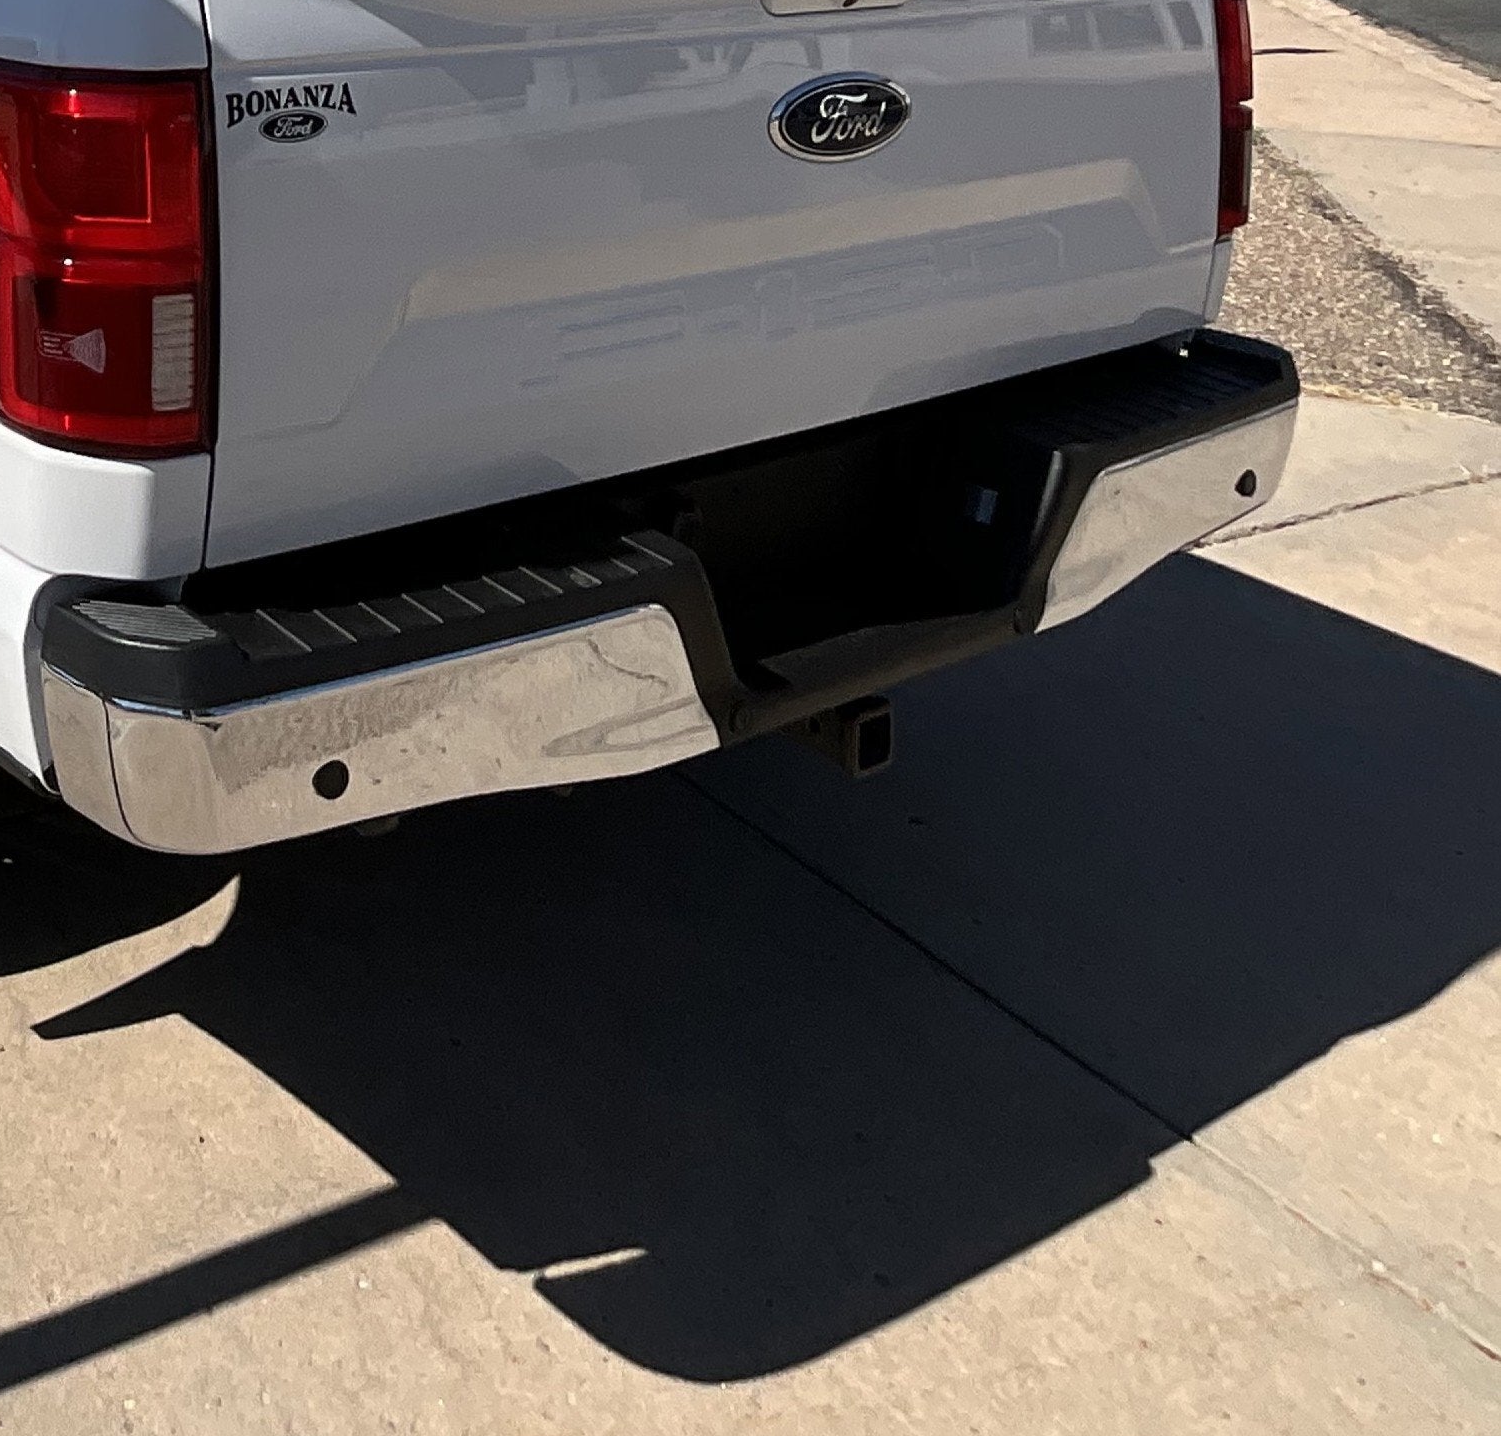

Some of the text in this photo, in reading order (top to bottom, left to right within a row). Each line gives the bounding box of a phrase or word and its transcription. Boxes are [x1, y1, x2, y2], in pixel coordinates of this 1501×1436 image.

[225, 82, 357, 128] BONANZA
[273, 116, 315, 138] Ford
[810, 92, 887, 144] Ford
